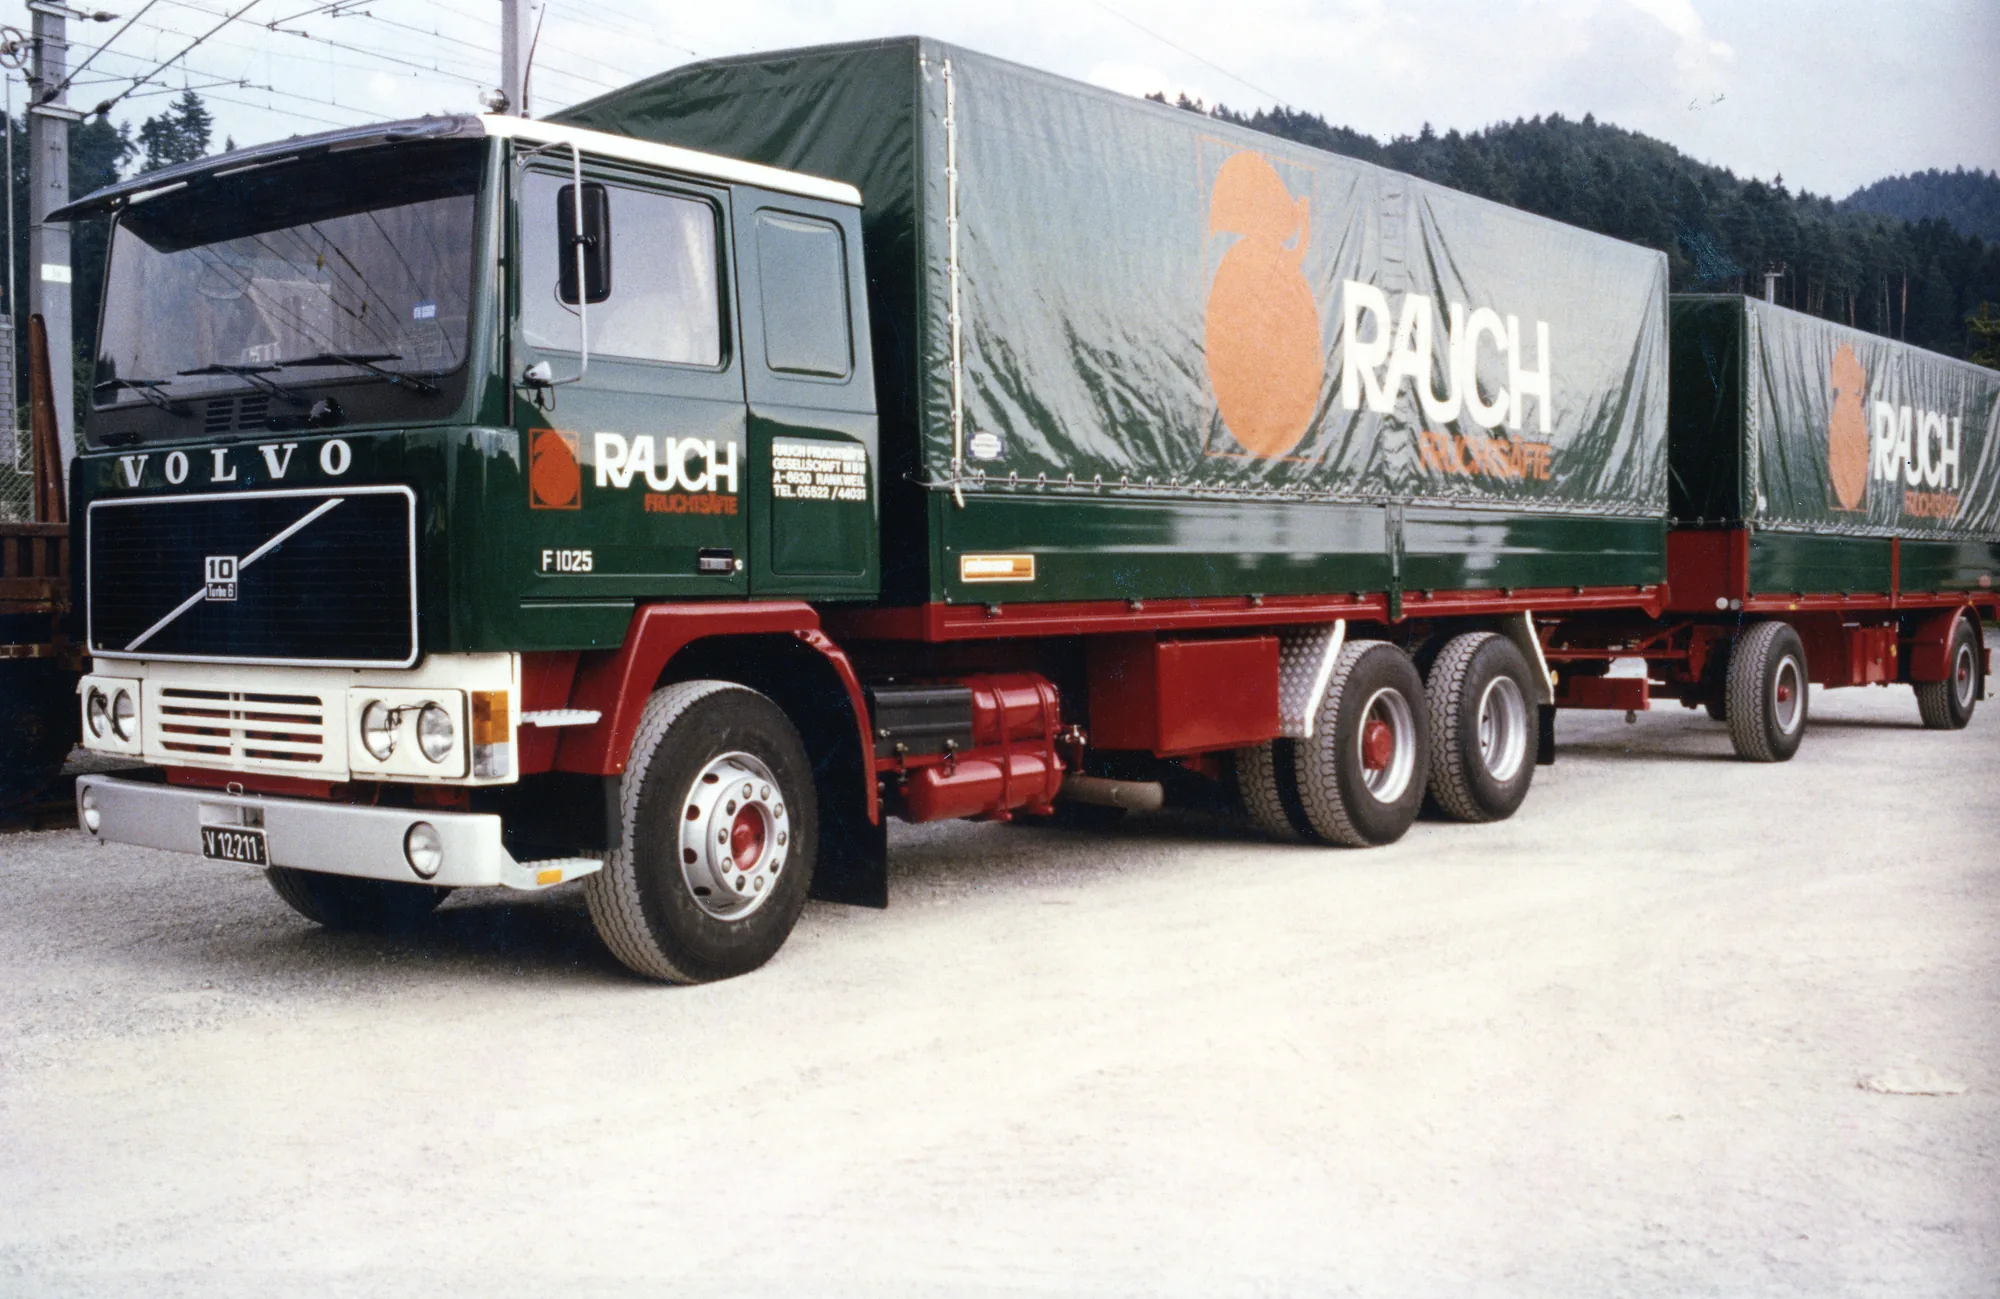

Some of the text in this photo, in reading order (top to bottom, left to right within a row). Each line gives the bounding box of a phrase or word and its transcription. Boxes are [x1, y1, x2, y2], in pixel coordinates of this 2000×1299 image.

[1341, 279, 1552, 434] RAUCH
[1873, 400, 1960, 489] RAUCH
[119, 439, 353, 488] VOLVO
[594, 432, 738, 493] RAUCH
[772, 457, 841, 474] GESELLSCHAFT
[815, 472, 866, 488] RANKWEIL
[644, 491, 738, 516] FRUCHTSÄFTE
[209, 559, 233, 579] 10
[228, 583, 234, 598] 6
[205, 831, 215, 856] V
